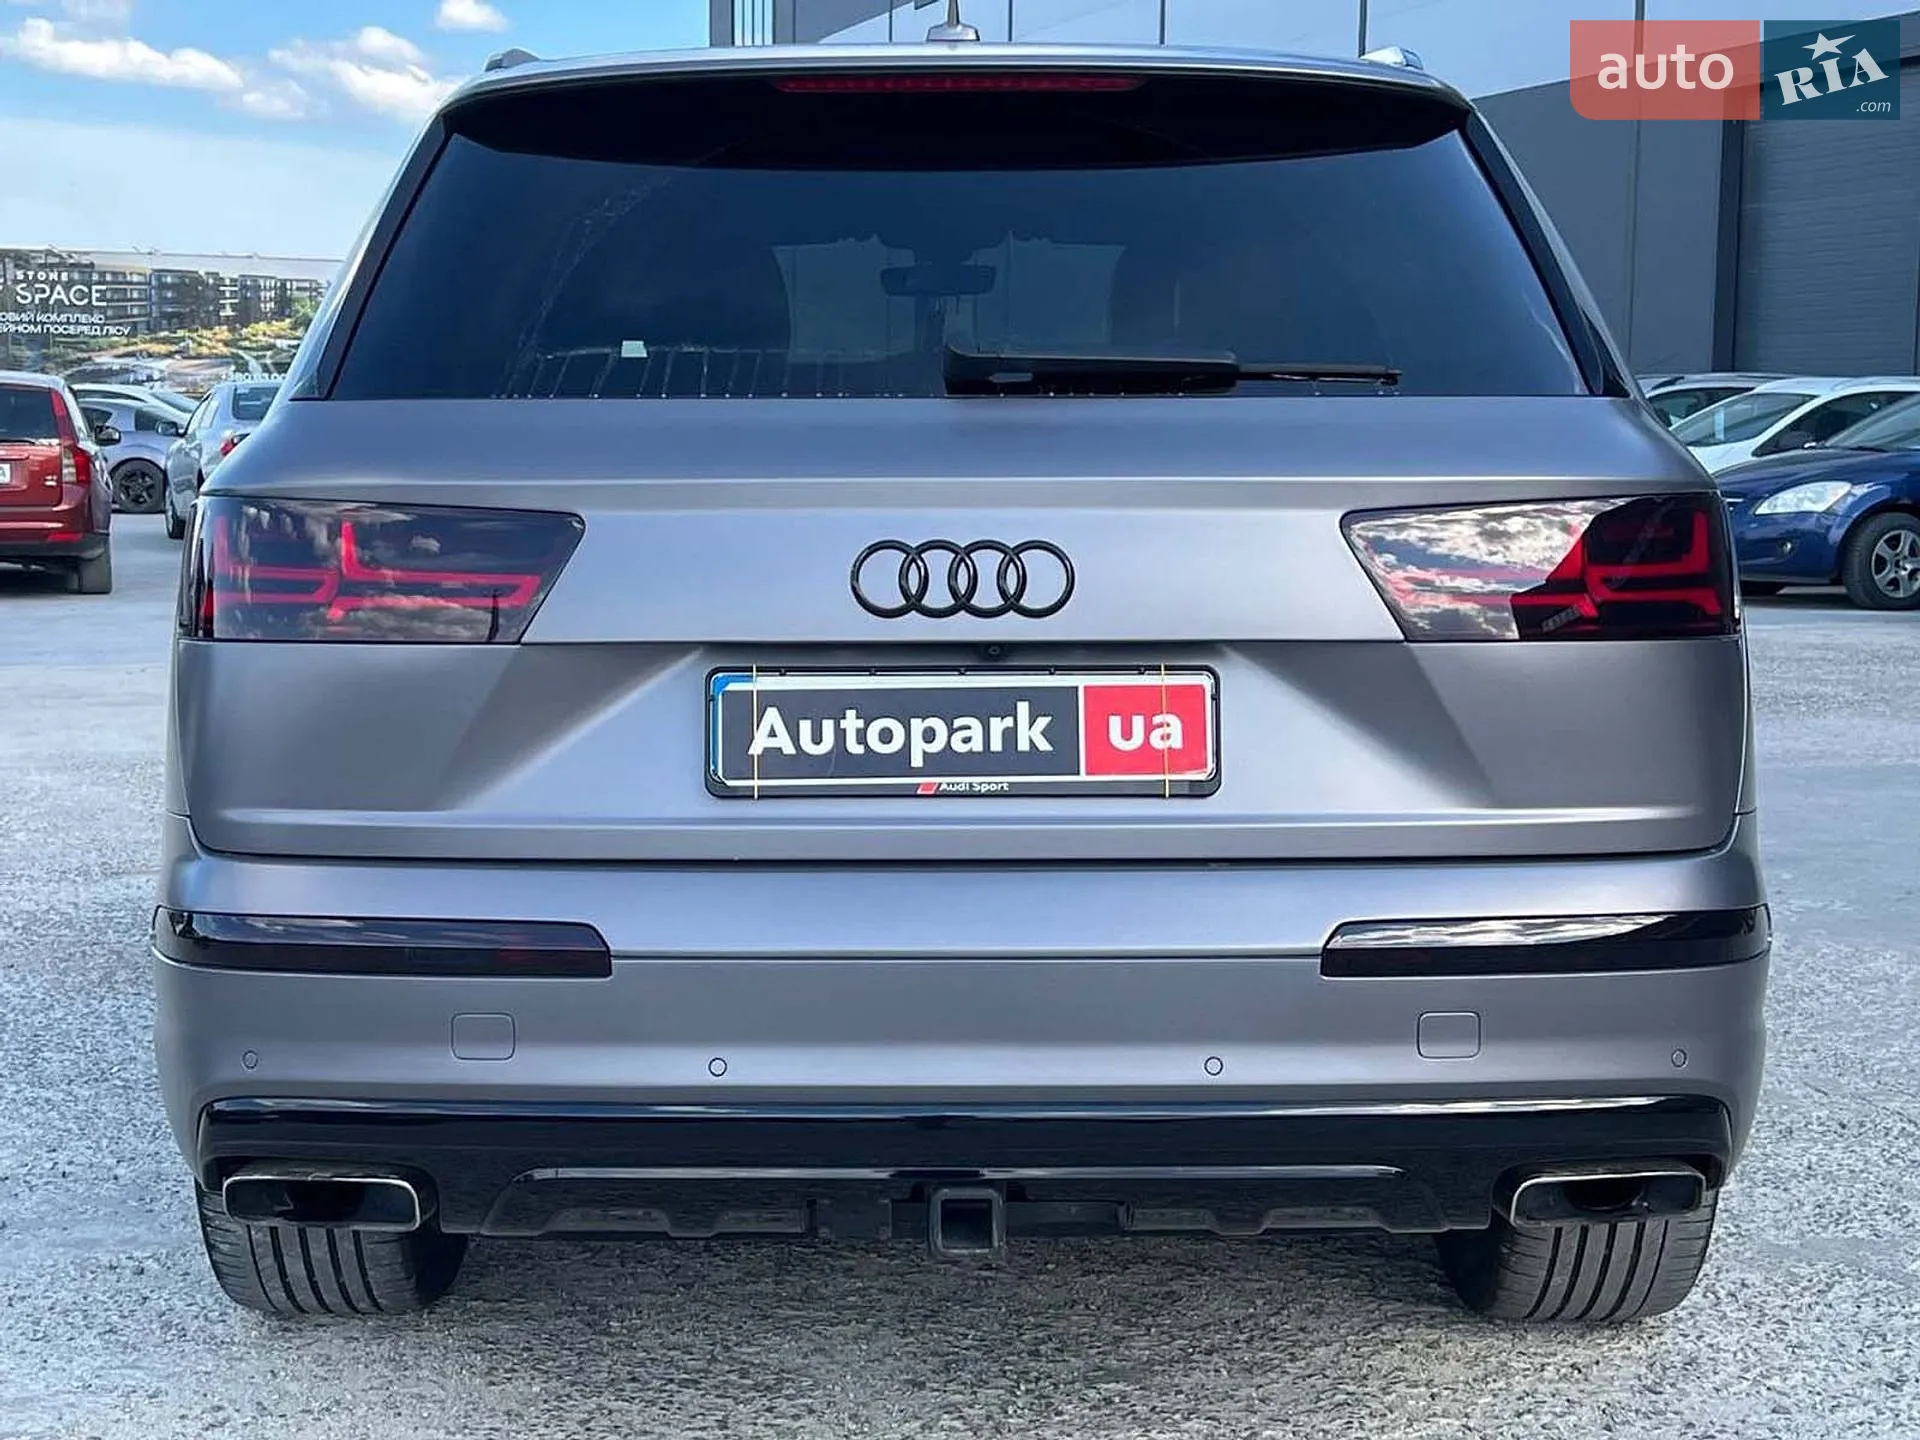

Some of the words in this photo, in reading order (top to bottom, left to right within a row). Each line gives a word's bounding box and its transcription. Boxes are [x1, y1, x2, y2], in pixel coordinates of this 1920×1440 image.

[16, 270, 69, 281] STONE
[16, 284, 107, 306] SPACE
[747, 701, 1054, 768] Autopark
[1107, 711, 1185, 751] ua
[939, 782, 970, 791] Audi
[972, 782, 1009, 793] Sport
